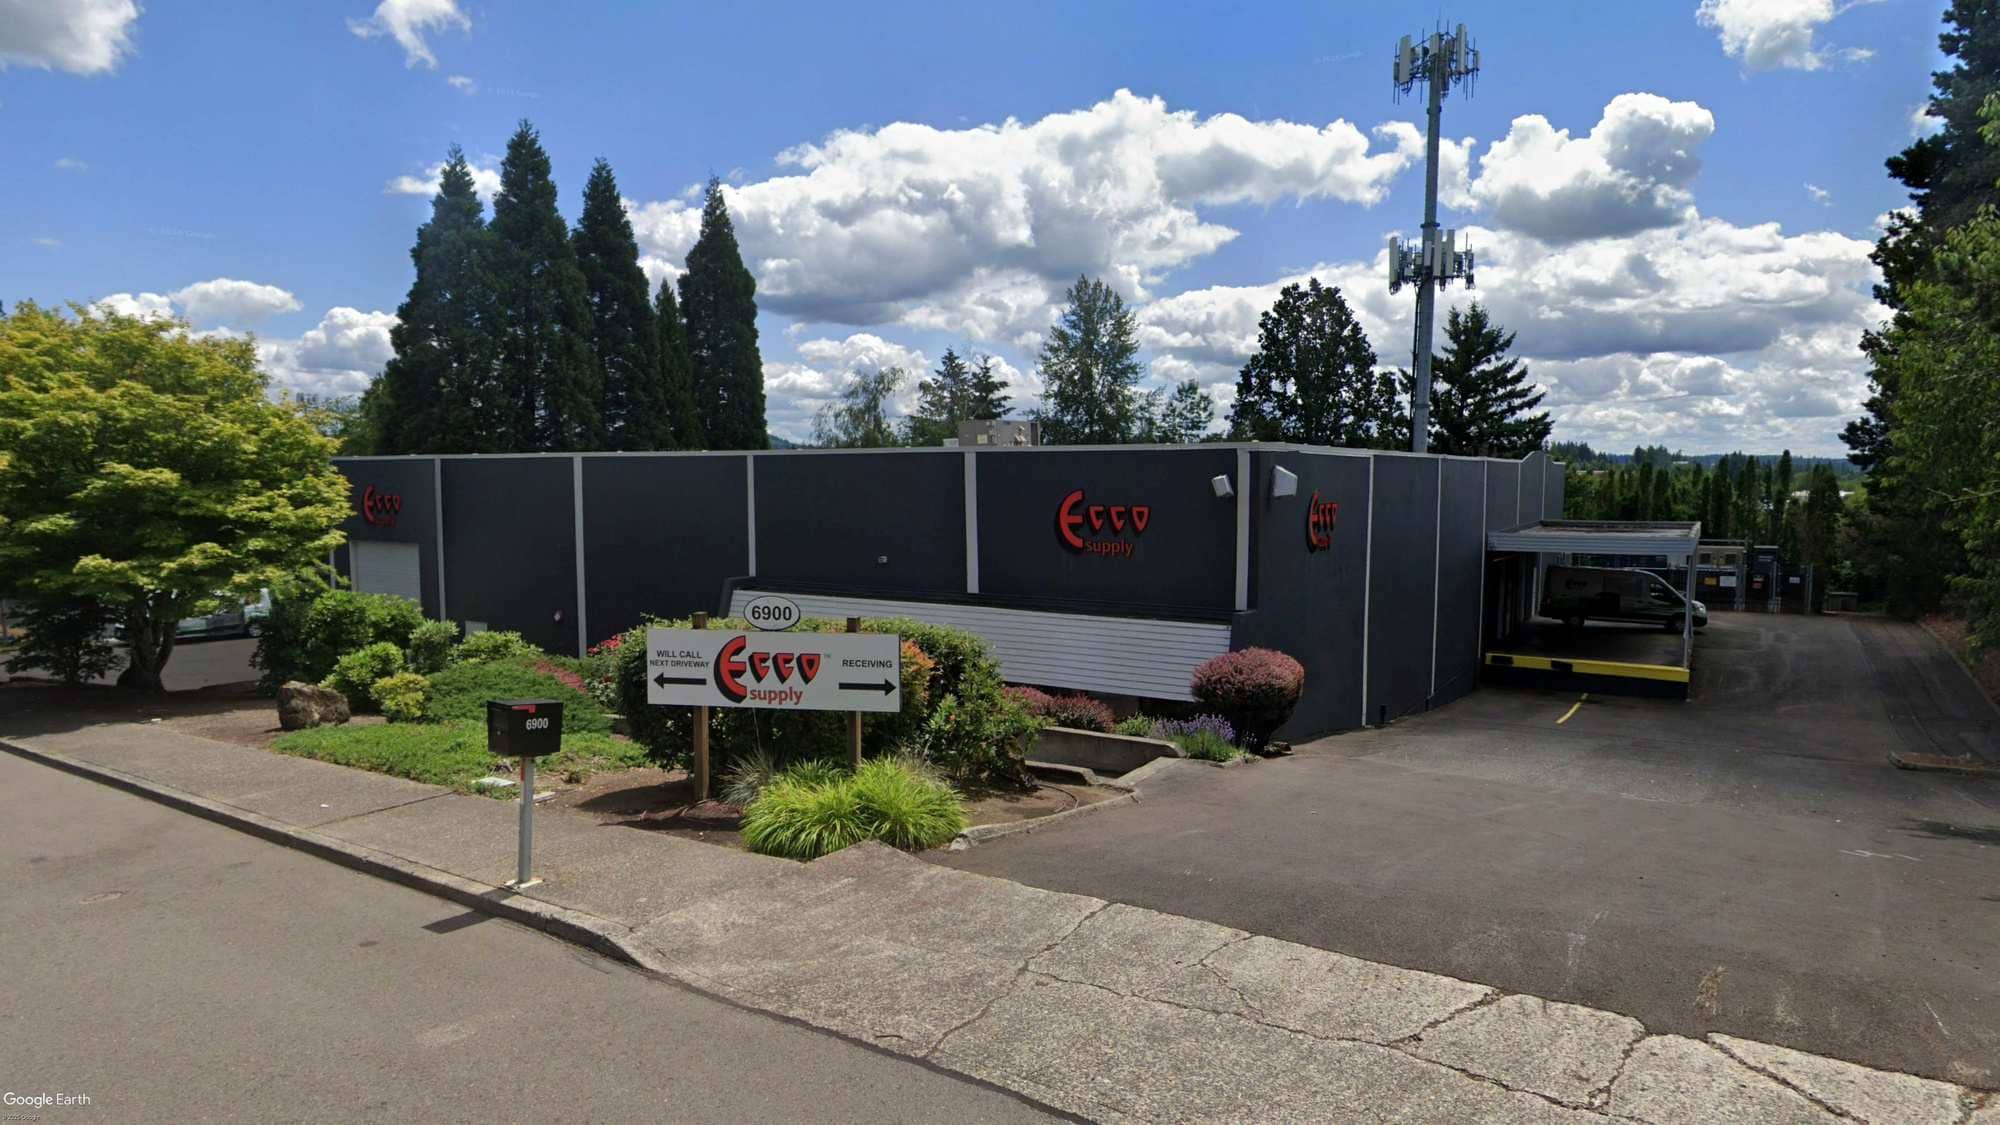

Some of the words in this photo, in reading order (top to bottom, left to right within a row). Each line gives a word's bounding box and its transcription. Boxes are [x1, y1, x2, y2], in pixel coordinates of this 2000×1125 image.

[1086, 541, 1133, 557] supply
[752, 606, 792, 621] 6900
[656, 650, 677, 658] WILL
[679, 650, 703, 659] CALL
[650, 659, 669, 667] NEXT
[671, 660, 709, 668] DRIVEWAY
[842, 659, 893, 668] RECEIVING
[749, 687, 803, 705] supply
[526, 718, 549, 730] 6900
